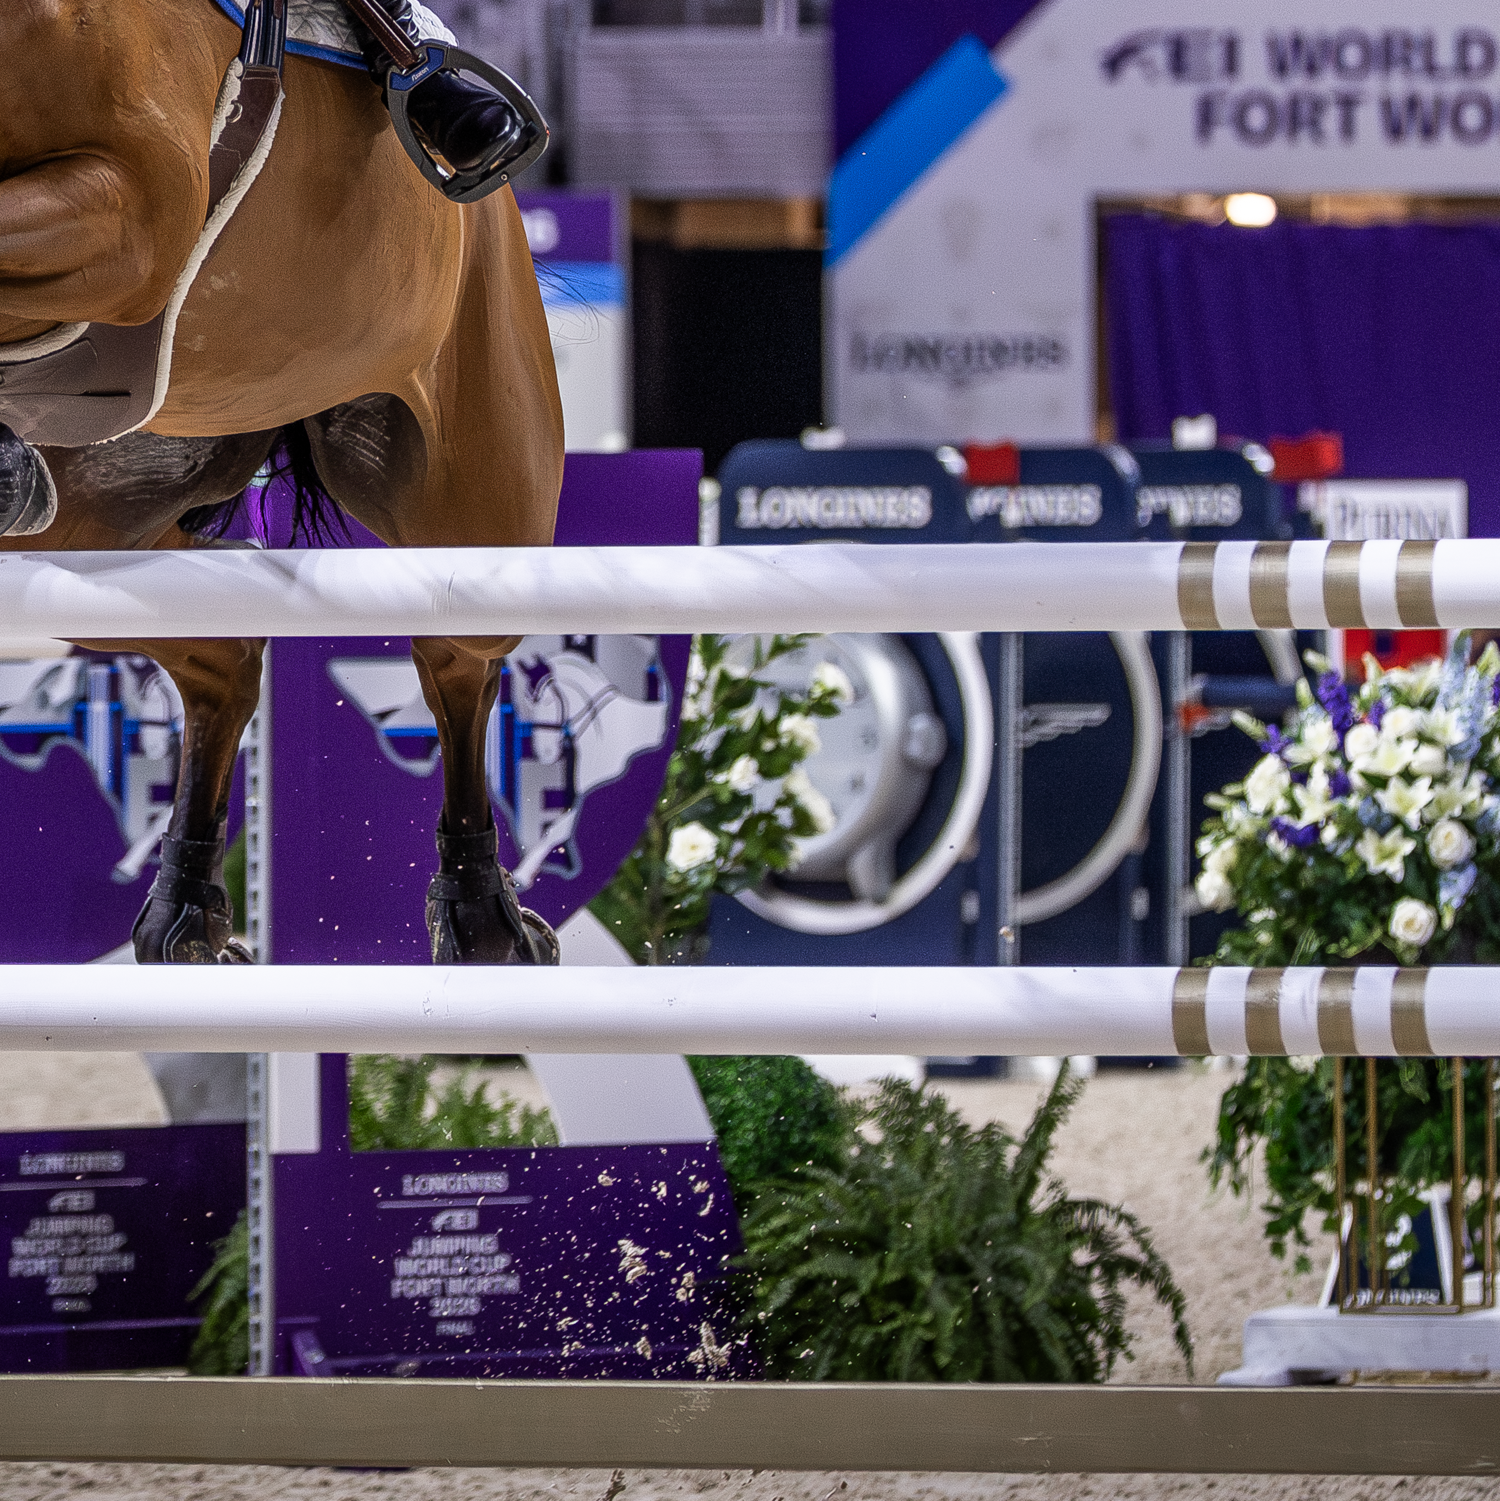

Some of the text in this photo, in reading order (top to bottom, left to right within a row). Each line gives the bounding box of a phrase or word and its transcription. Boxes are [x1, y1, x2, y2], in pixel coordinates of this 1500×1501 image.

[1264, 25, 1499, 85] WORLD
[1196, 87, 1365, 149] FORT
[736, 485, 934, 529] LONGINES
[401, 1171, 510, 1197] LONGINES
